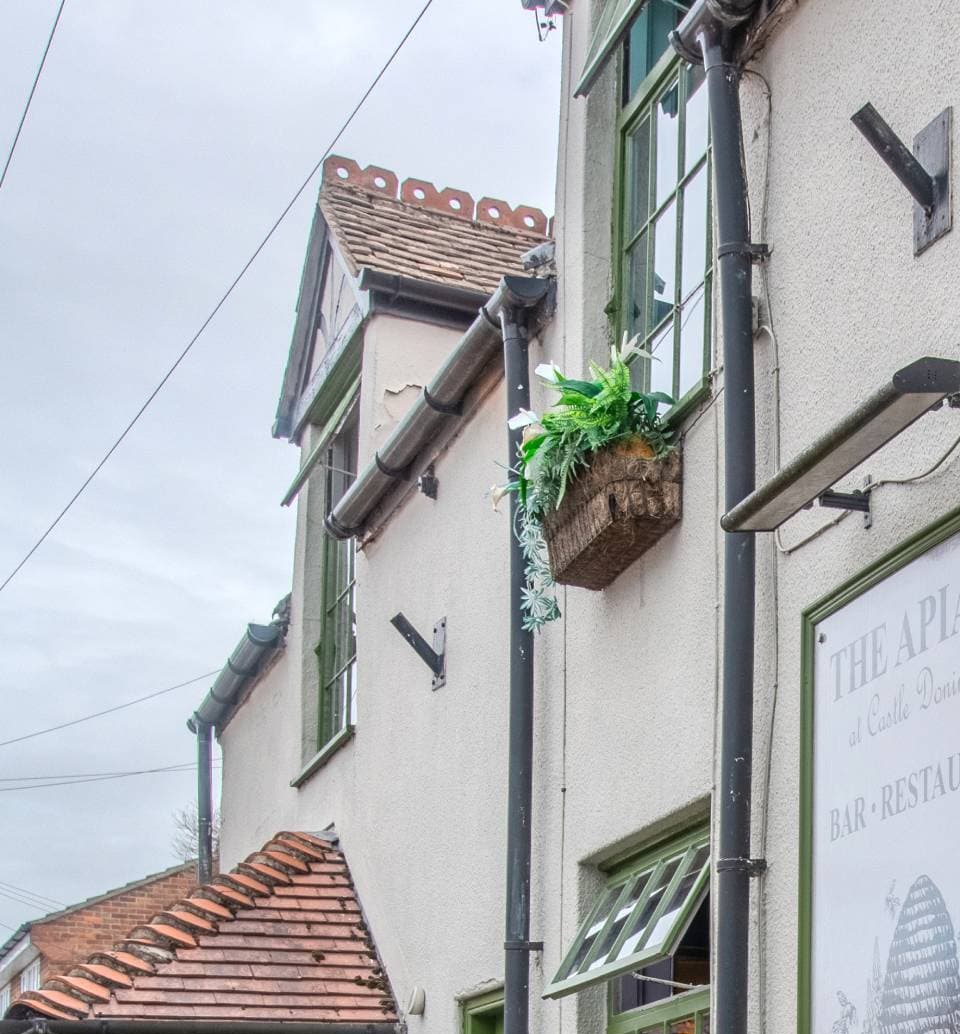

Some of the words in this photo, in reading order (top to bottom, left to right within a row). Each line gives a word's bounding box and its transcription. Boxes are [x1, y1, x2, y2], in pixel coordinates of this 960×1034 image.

[830, 622, 888, 702] THE
[849, 717, 863, 747] at
[866, 682, 911, 738] Castle
[829, 796, 867, 842] BAR
